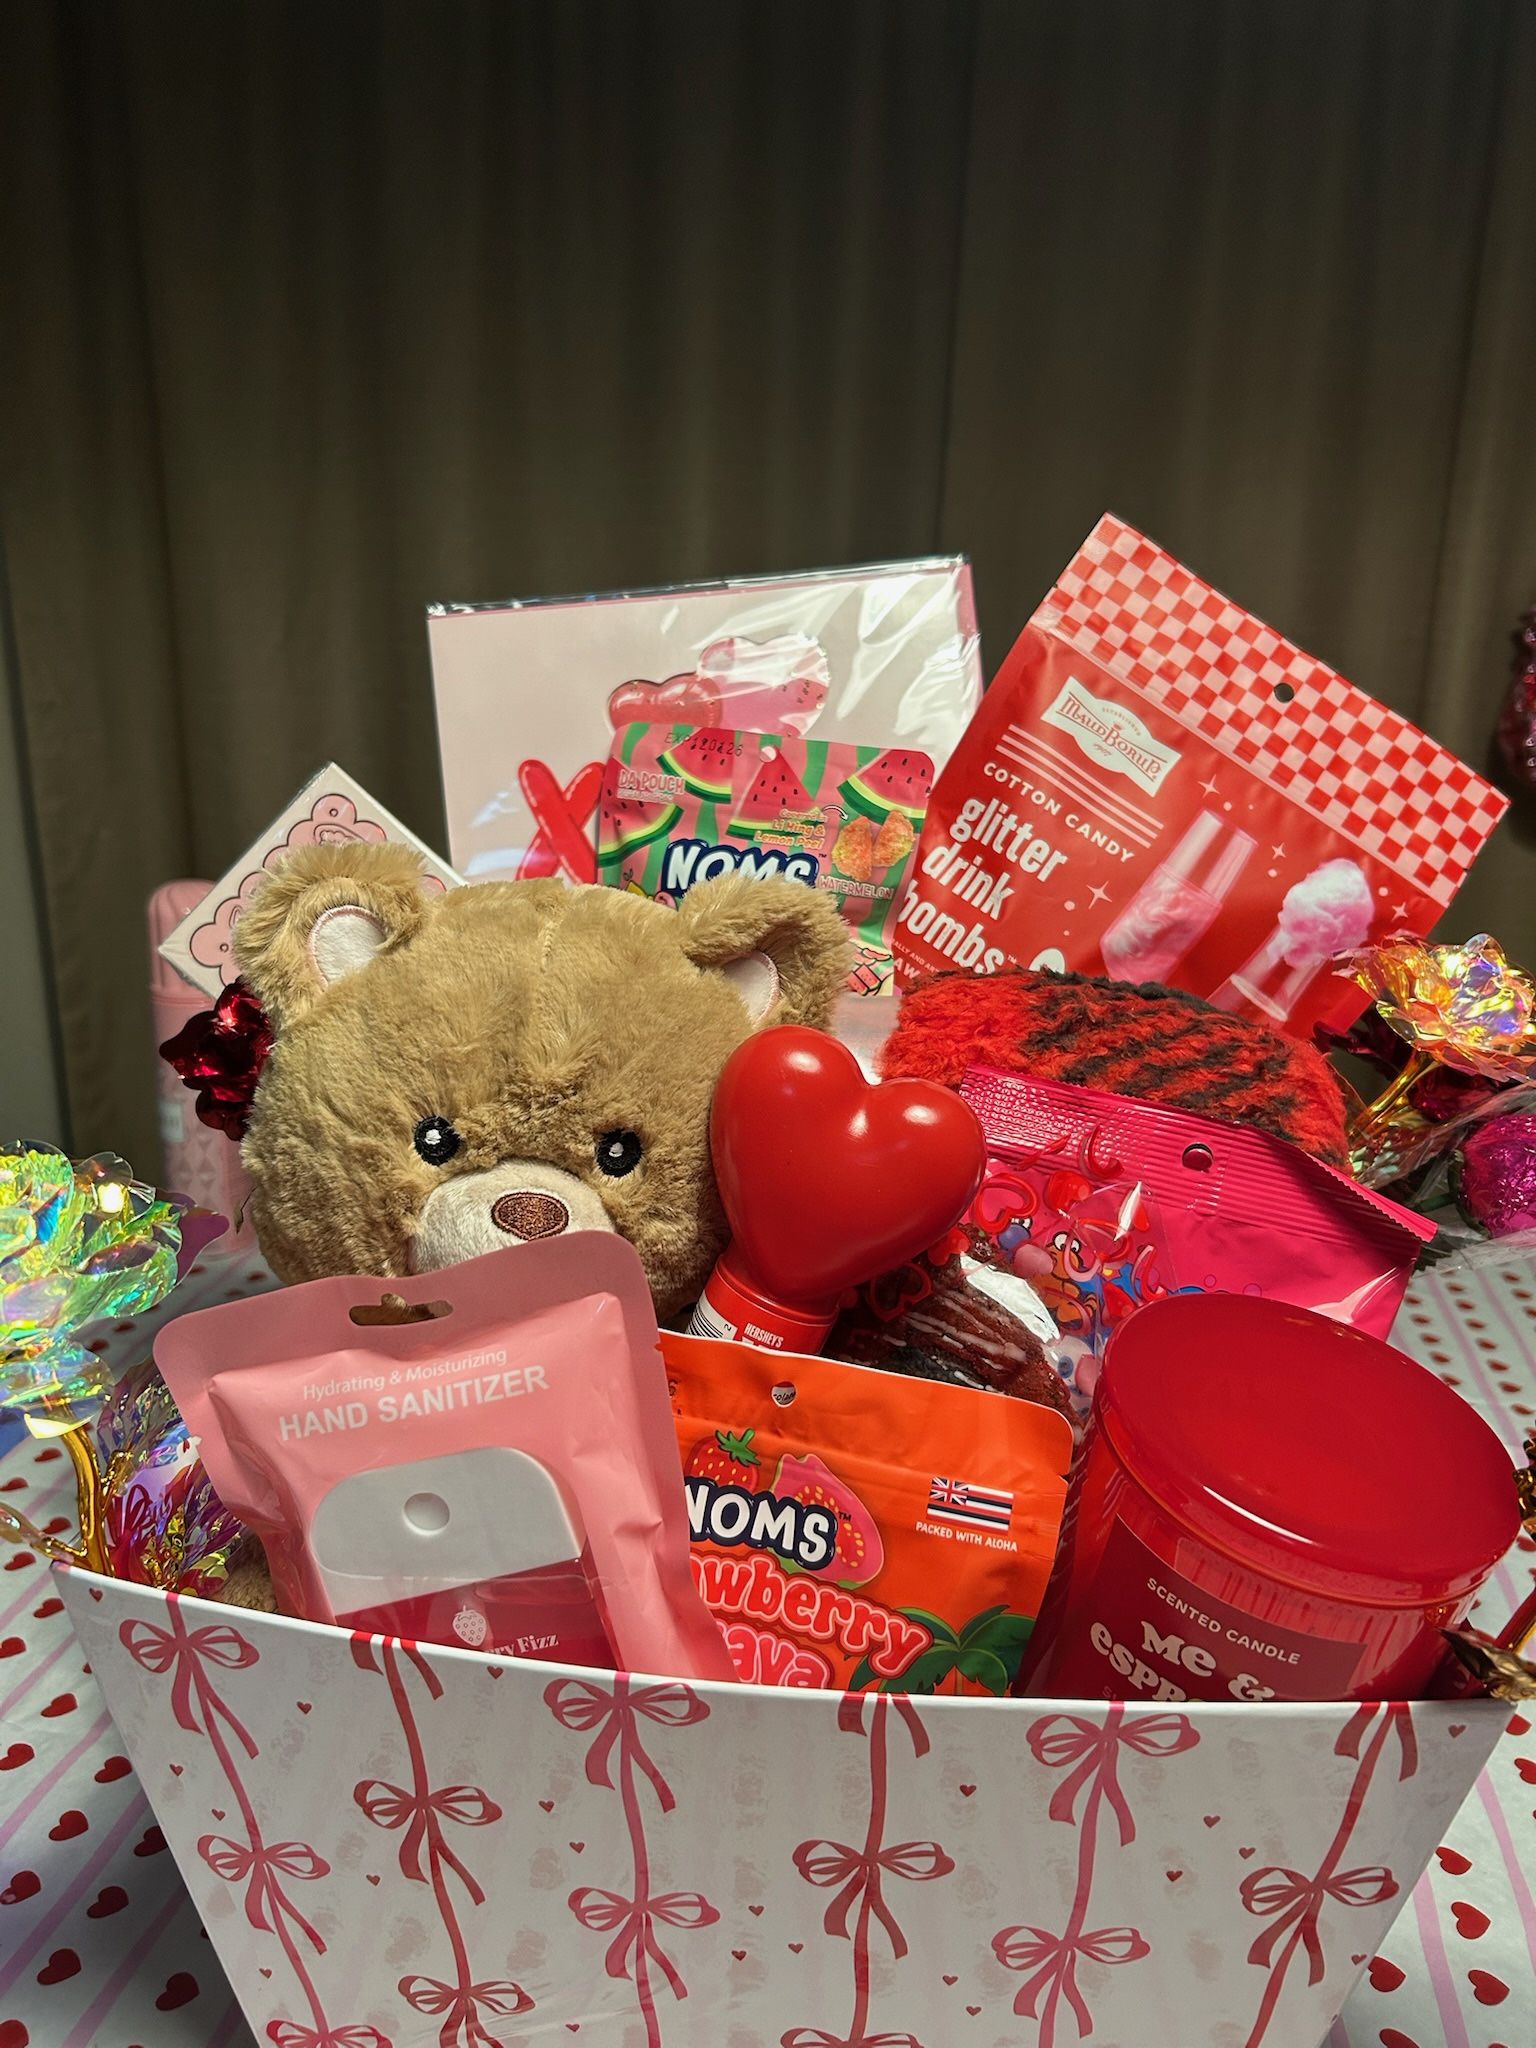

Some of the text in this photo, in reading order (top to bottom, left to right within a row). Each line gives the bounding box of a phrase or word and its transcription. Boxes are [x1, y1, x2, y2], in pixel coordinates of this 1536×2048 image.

[619, 768, 687, 795] DA POUCH
[814, 825, 826, 836] &
[983, 762, 1135, 864] COTTON CANDY
[755, 831, 824, 849] Lemon Peel
[949, 798, 1068, 883] glitter
[820, 874, 894, 899] WATERMELON
[921, 843, 1016, 921] drink
[910, 952, 925, 966] AND
[744, 1322, 784, 1348] HERSHEY'S
[303, 1349, 508, 1402] Hydrating & Moisturizing
[279, 1364, 550, 1441] HAND SANITIZER
[685, 1482, 834, 1564] NOMS
[916, 1521, 1018, 1552] PACKED WITH ALOHA
[517, 1634, 559, 1653] Fizz
[1146, 1577, 1300, 1664] SCENTED CANDLE
[717, 1621, 830, 1688] ava
[1141, 1621, 1217, 1678] Me
